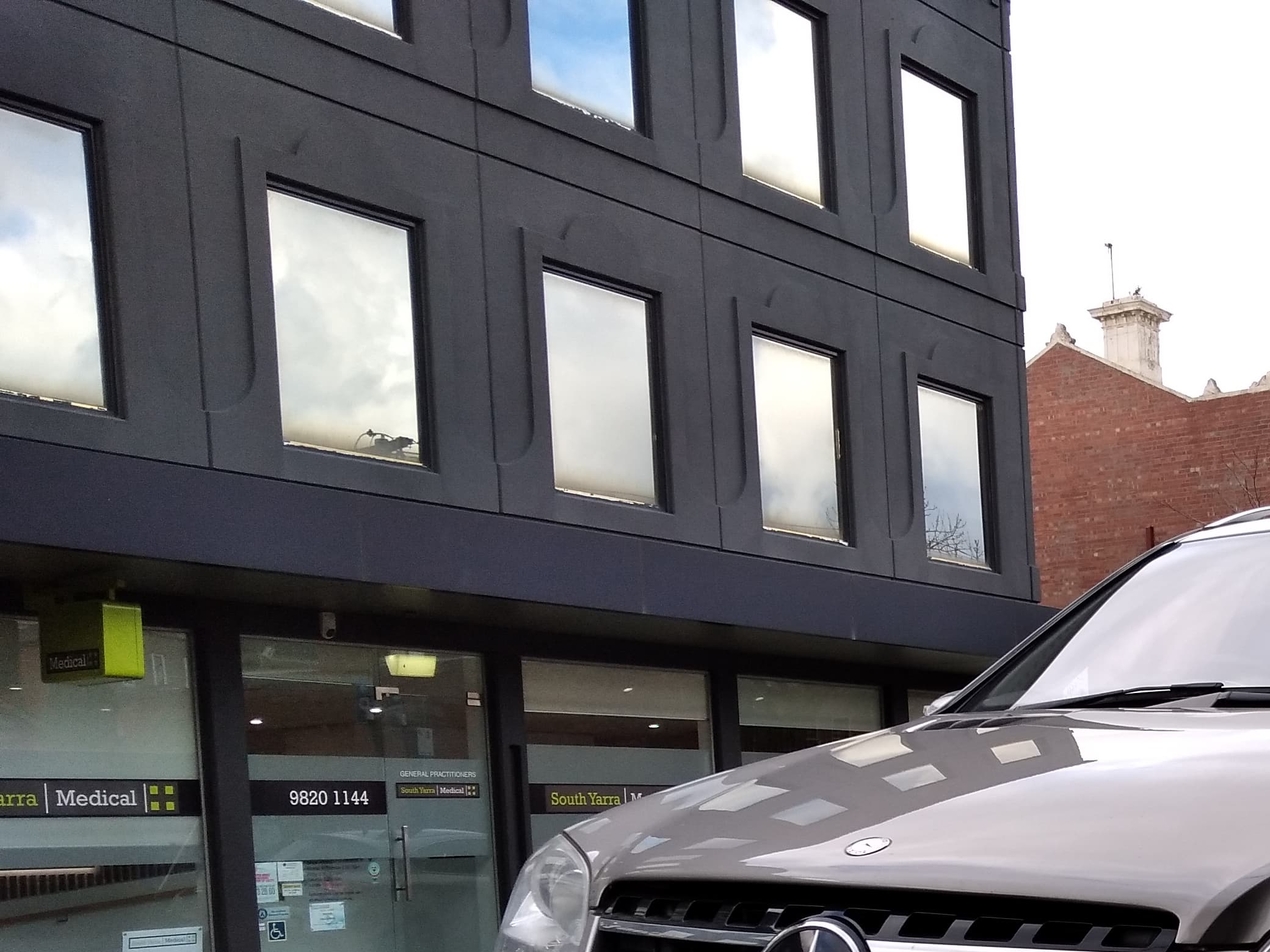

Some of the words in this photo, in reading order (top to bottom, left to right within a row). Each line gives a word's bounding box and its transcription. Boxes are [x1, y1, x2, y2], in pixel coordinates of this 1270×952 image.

[50, 654, 87, 670] Medical
[400, 770, 429, 778] GENERAL
[401, 786, 419, 794] South
[56, 790, 137, 807] Medical
[289, 790, 328, 806] 9820
[333, 790, 369, 805] 1144
[551, 792, 587, 806] South
[587, 792, 621, 806] Yarra
